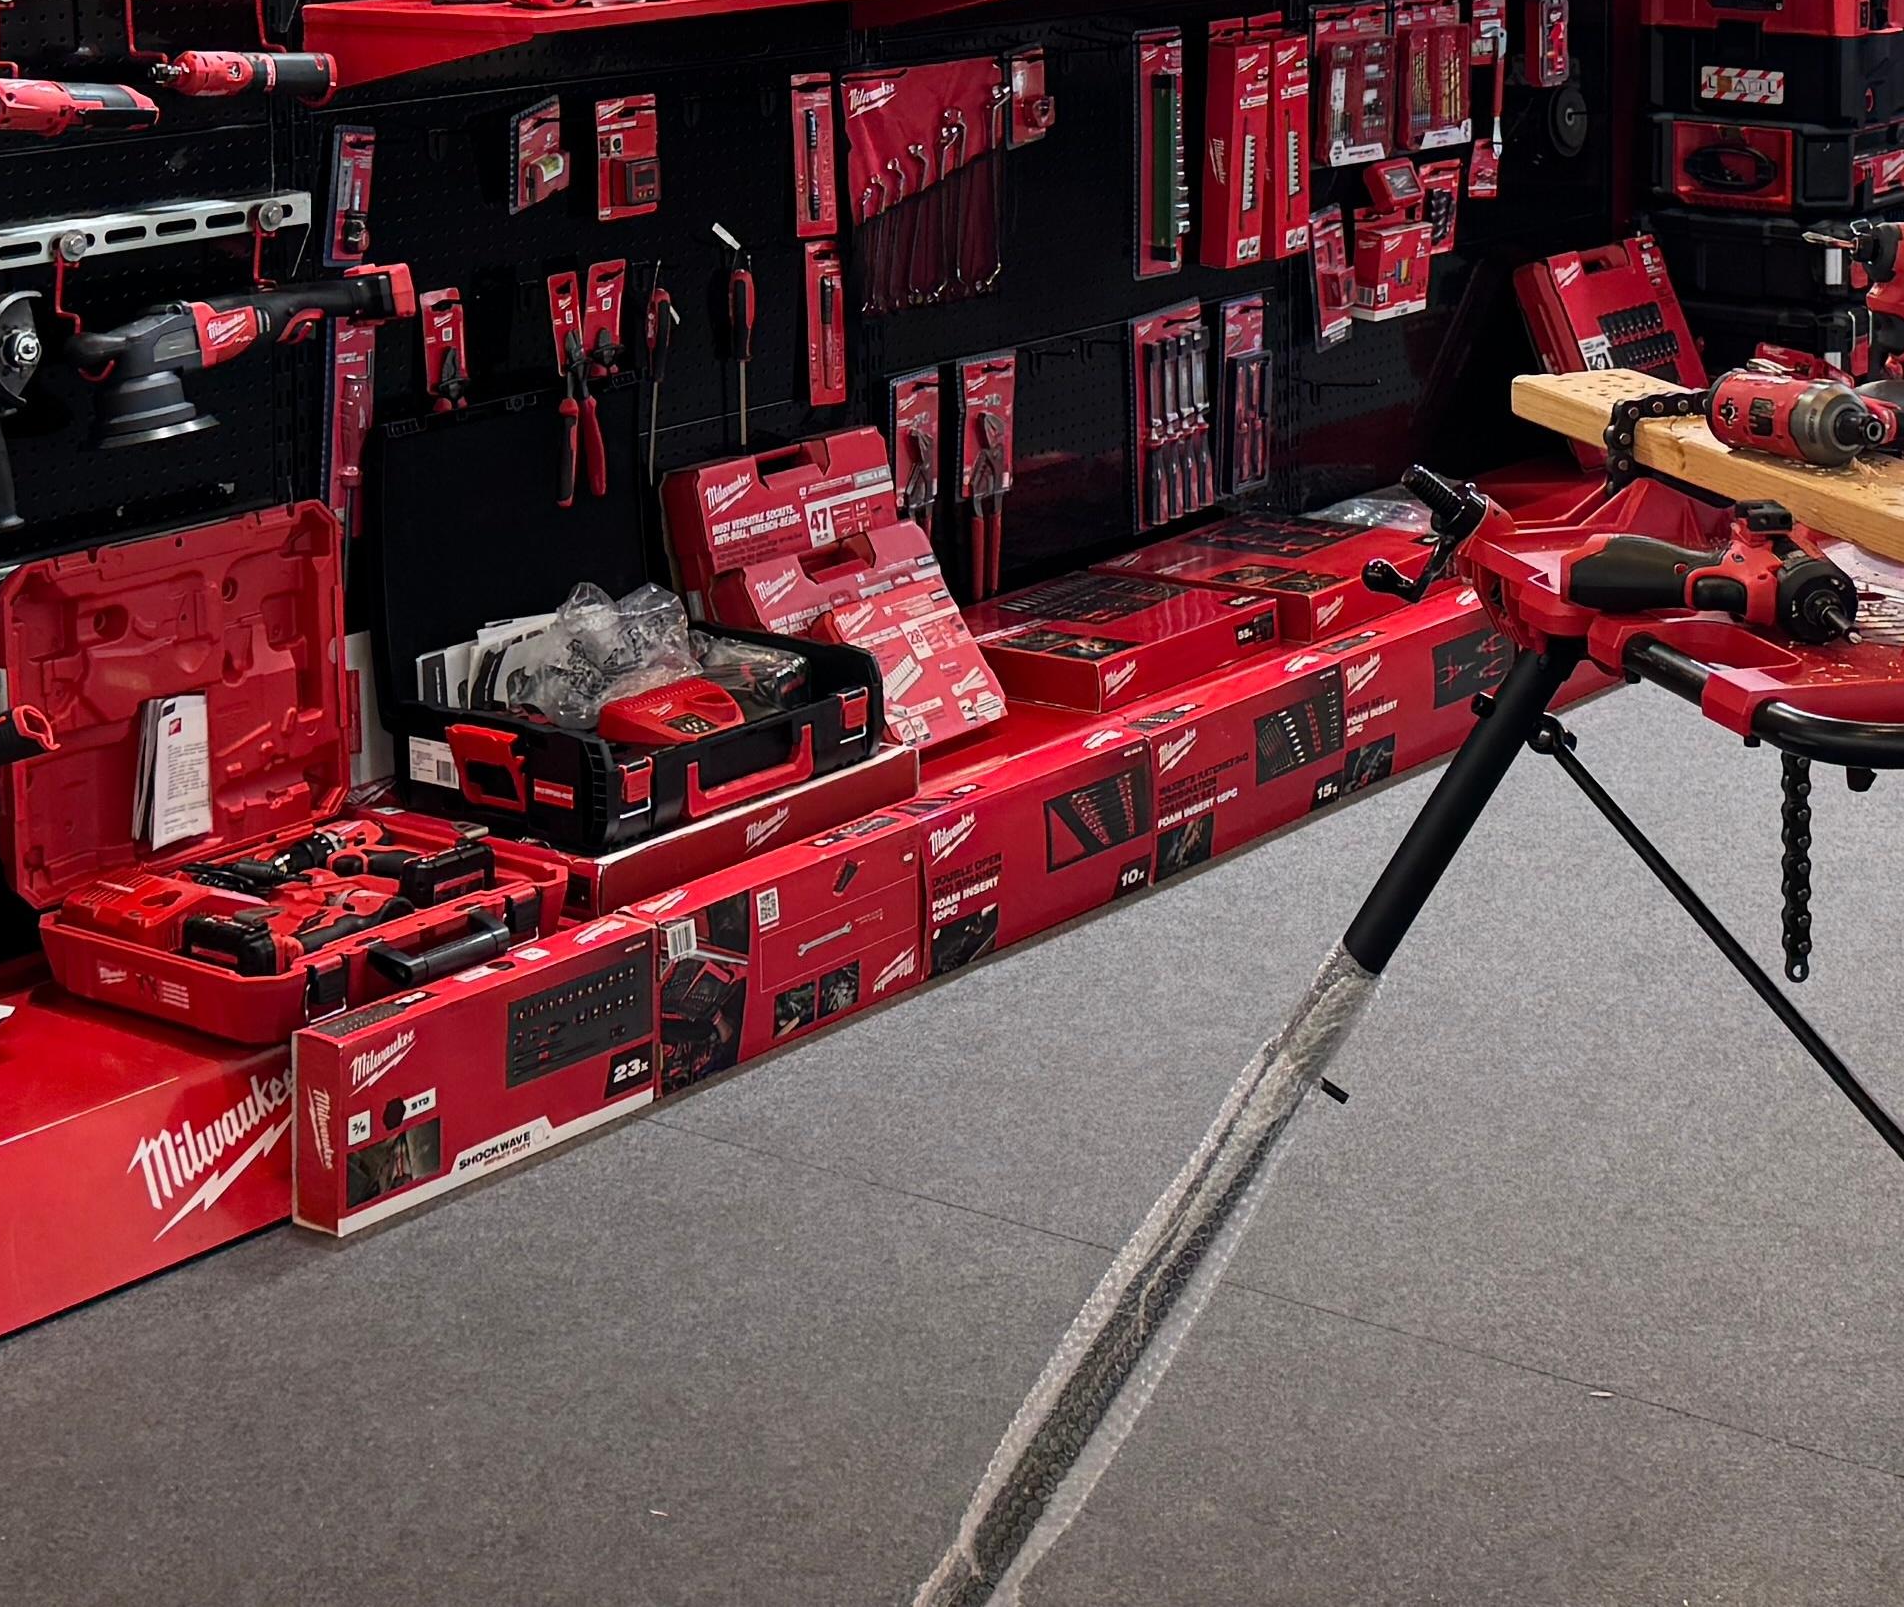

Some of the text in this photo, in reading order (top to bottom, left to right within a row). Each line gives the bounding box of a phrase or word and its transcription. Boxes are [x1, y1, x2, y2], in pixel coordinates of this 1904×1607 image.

[932, 875, 999, 912] FOAM INSERT
[348, 1028, 416, 1086] Milwaukee
[459, 1131, 531, 1170] SHOCKWAVE
